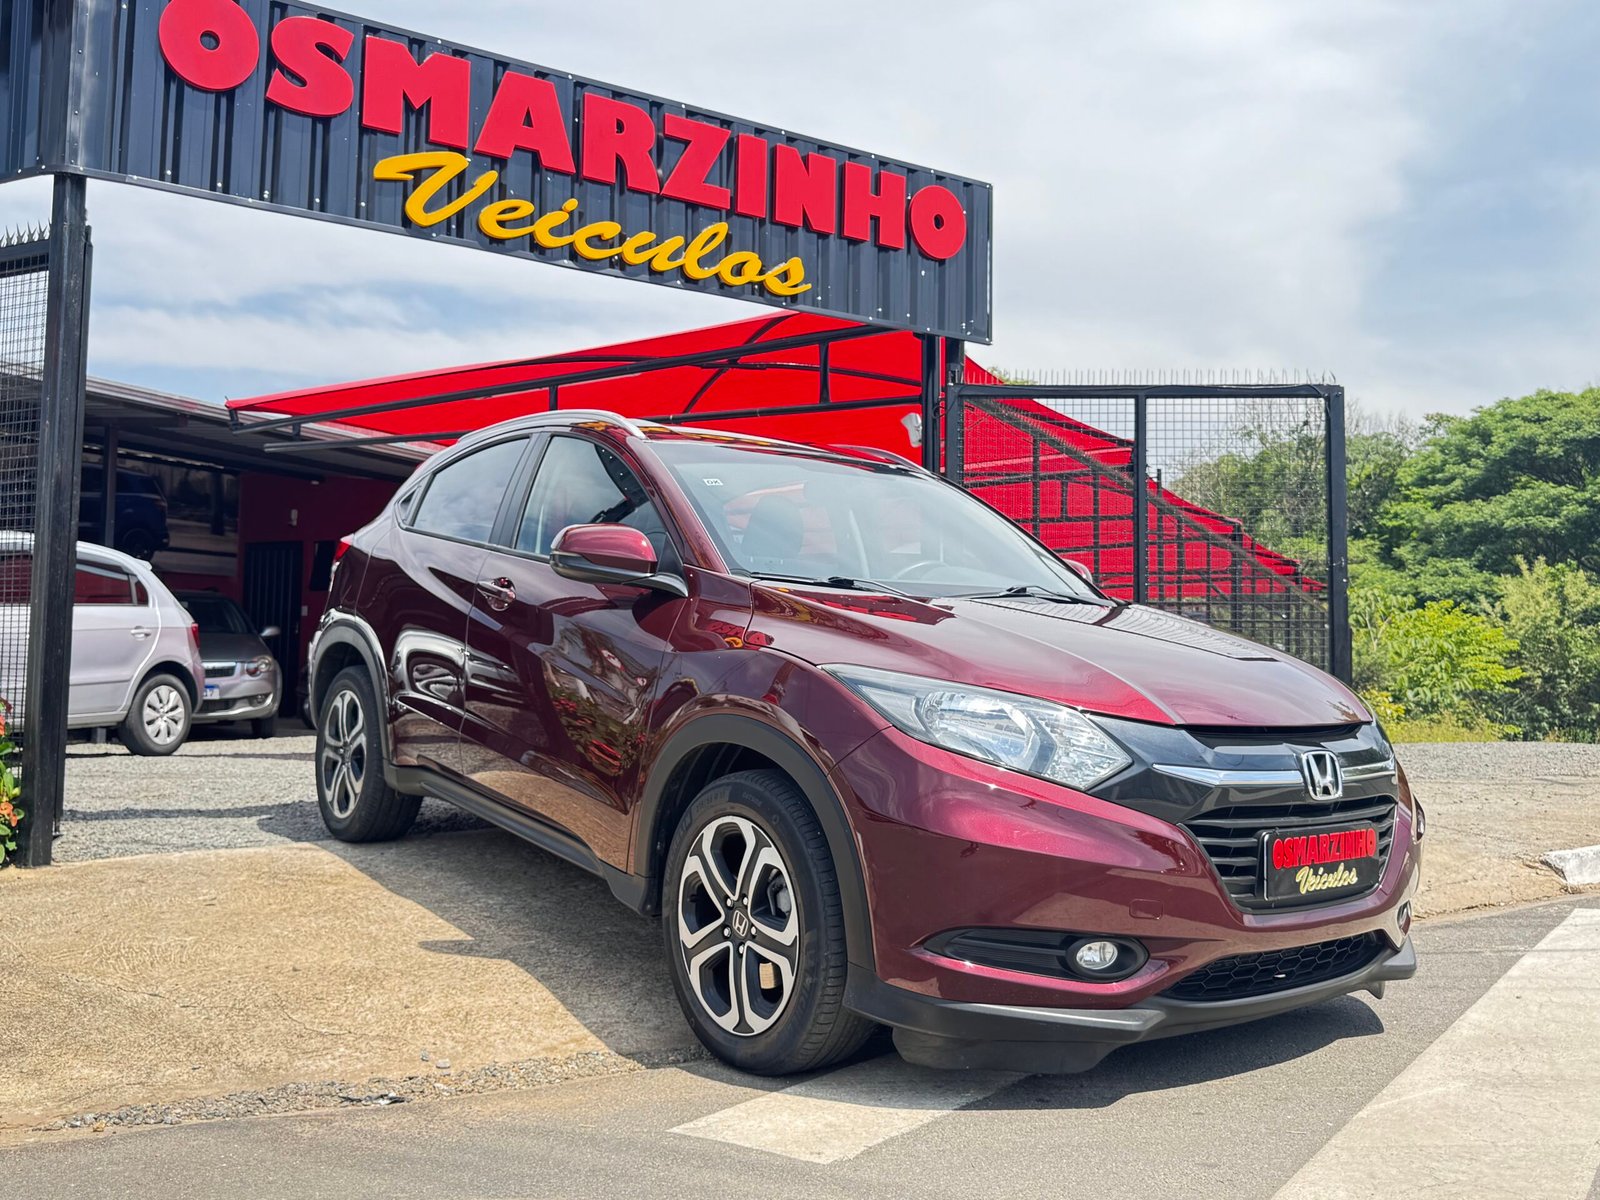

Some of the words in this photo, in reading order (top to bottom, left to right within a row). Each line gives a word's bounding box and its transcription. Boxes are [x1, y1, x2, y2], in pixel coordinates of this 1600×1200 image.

[158, 0, 968, 260] OSMARZINHO
[373, 151, 812, 297] Veiculos
[1272, 827, 1377, 870] OSMARZINHO
[1295, 862, 1359, 895] Veiculos
